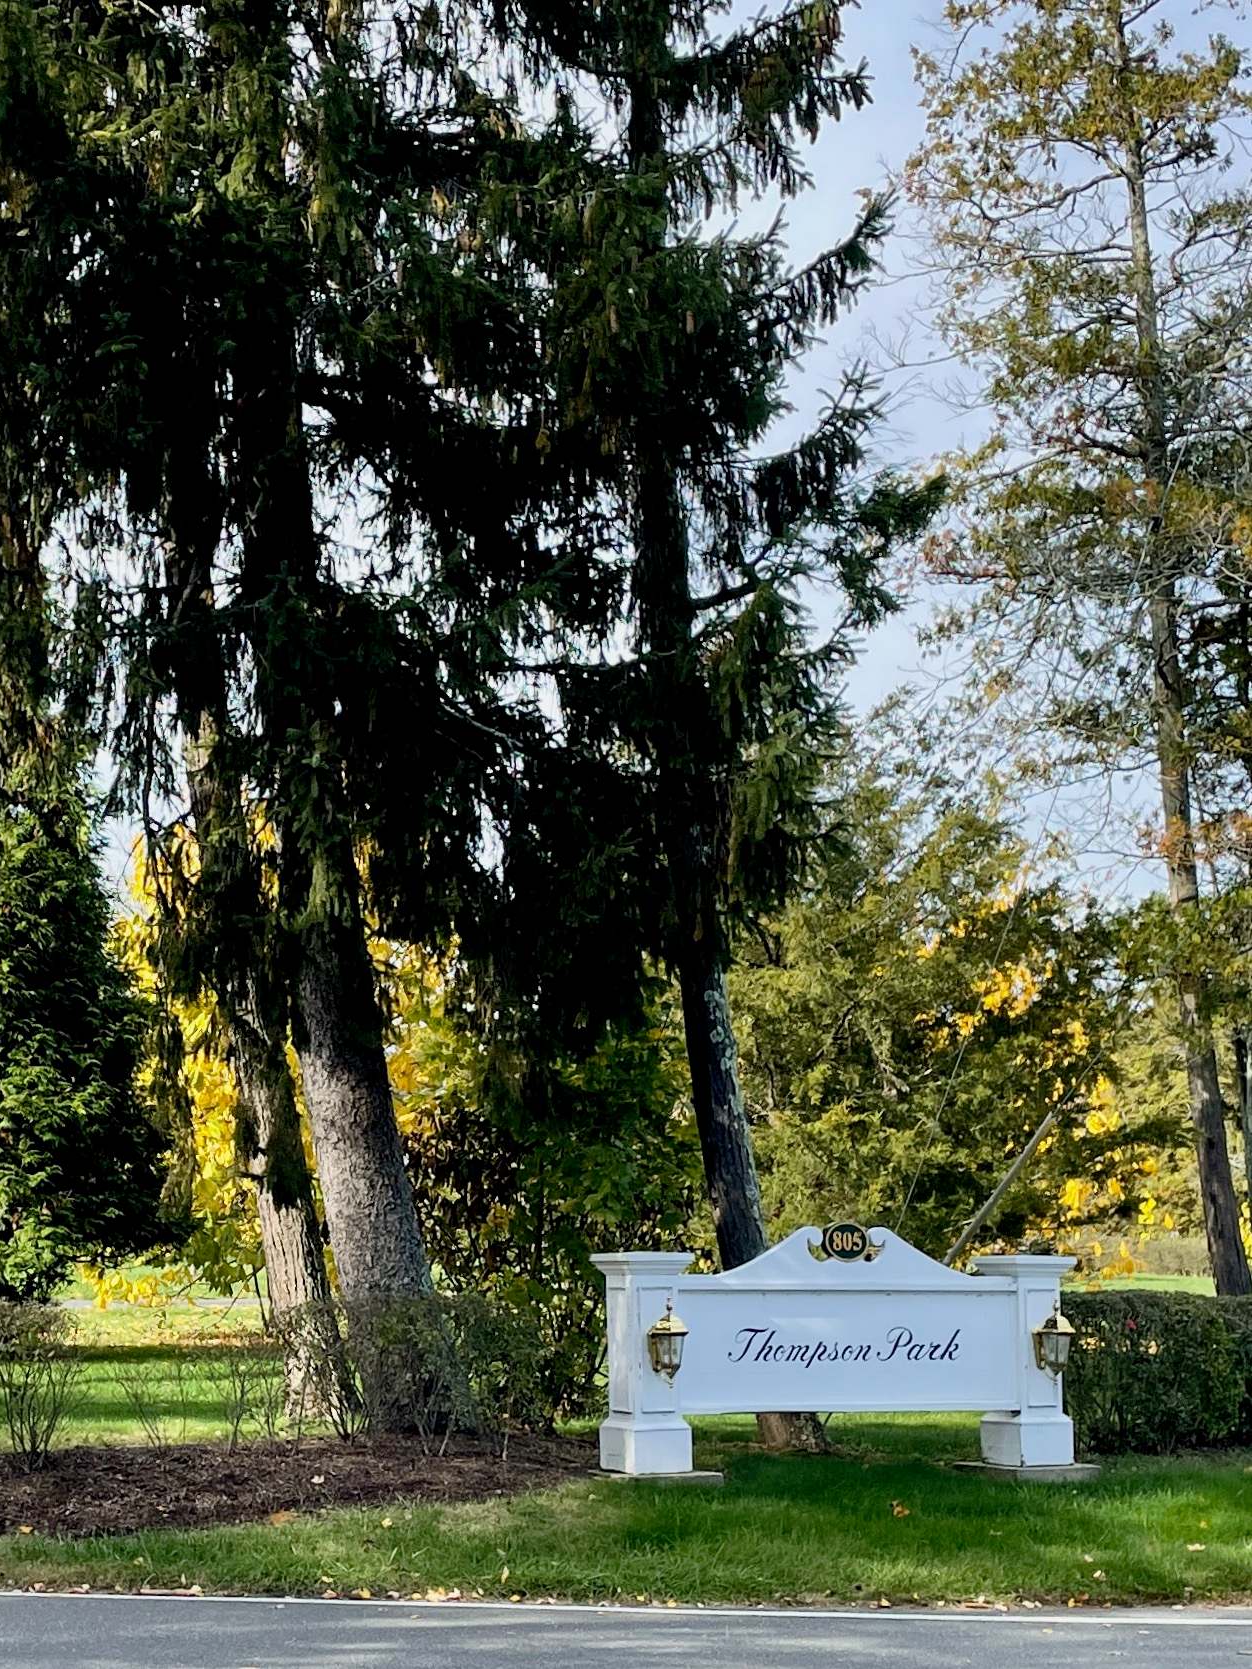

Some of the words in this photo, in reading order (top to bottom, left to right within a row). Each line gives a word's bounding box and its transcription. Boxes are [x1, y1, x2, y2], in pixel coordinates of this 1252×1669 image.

[832, 1231, 863, 1252] 805
[727, 1327, 872, 1369] Thompson
[876, 1326, 962, 1362] Park
